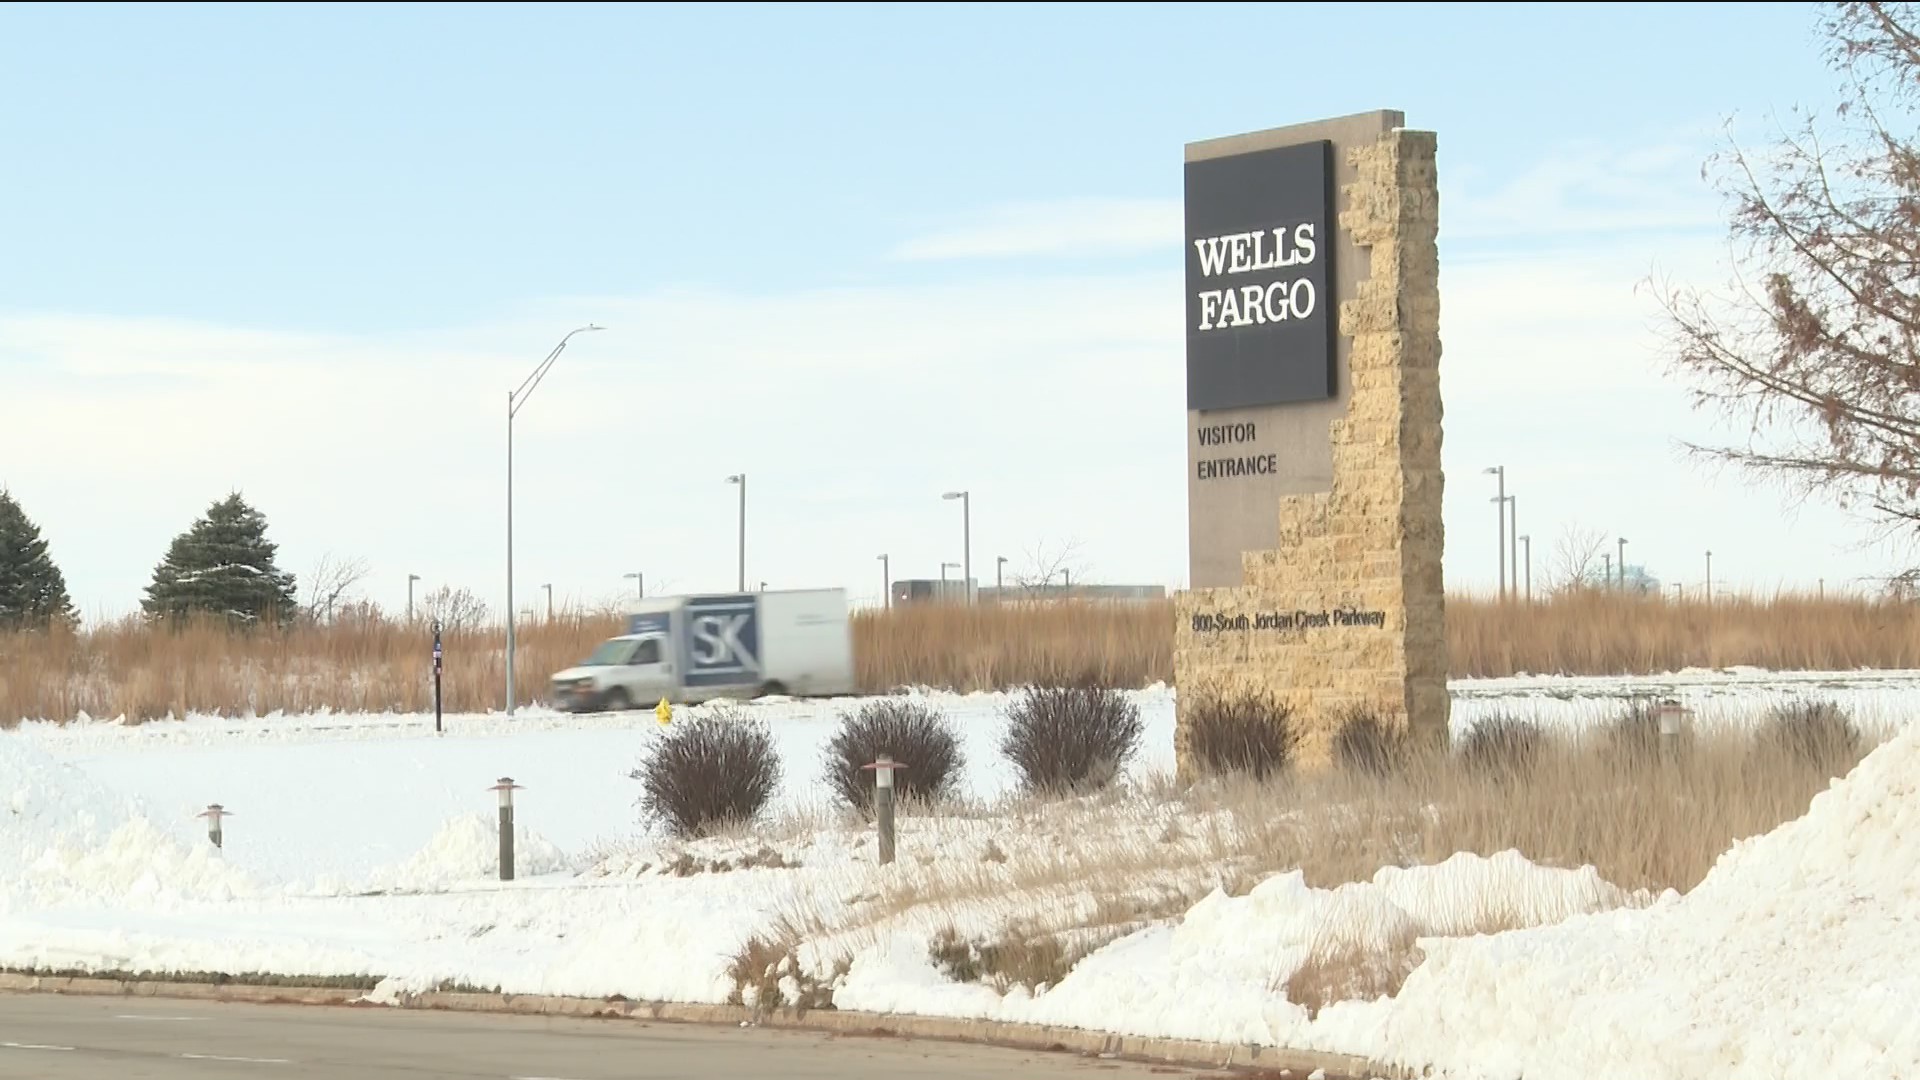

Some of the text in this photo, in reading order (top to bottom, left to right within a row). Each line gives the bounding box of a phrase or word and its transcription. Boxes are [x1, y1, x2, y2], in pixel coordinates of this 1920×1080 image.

[1194, 223, 1316, 277] WELLS
[1198, 278, 1315, 331] FARGO
[1198, 423, 1256, 446] VISITOR
[1197, 454, 1277, 480] ENTRANCE
[1192, 608, 1386, 632] 800 South Jordan Creek Parkway
[691, 614, 760, 672] SK
